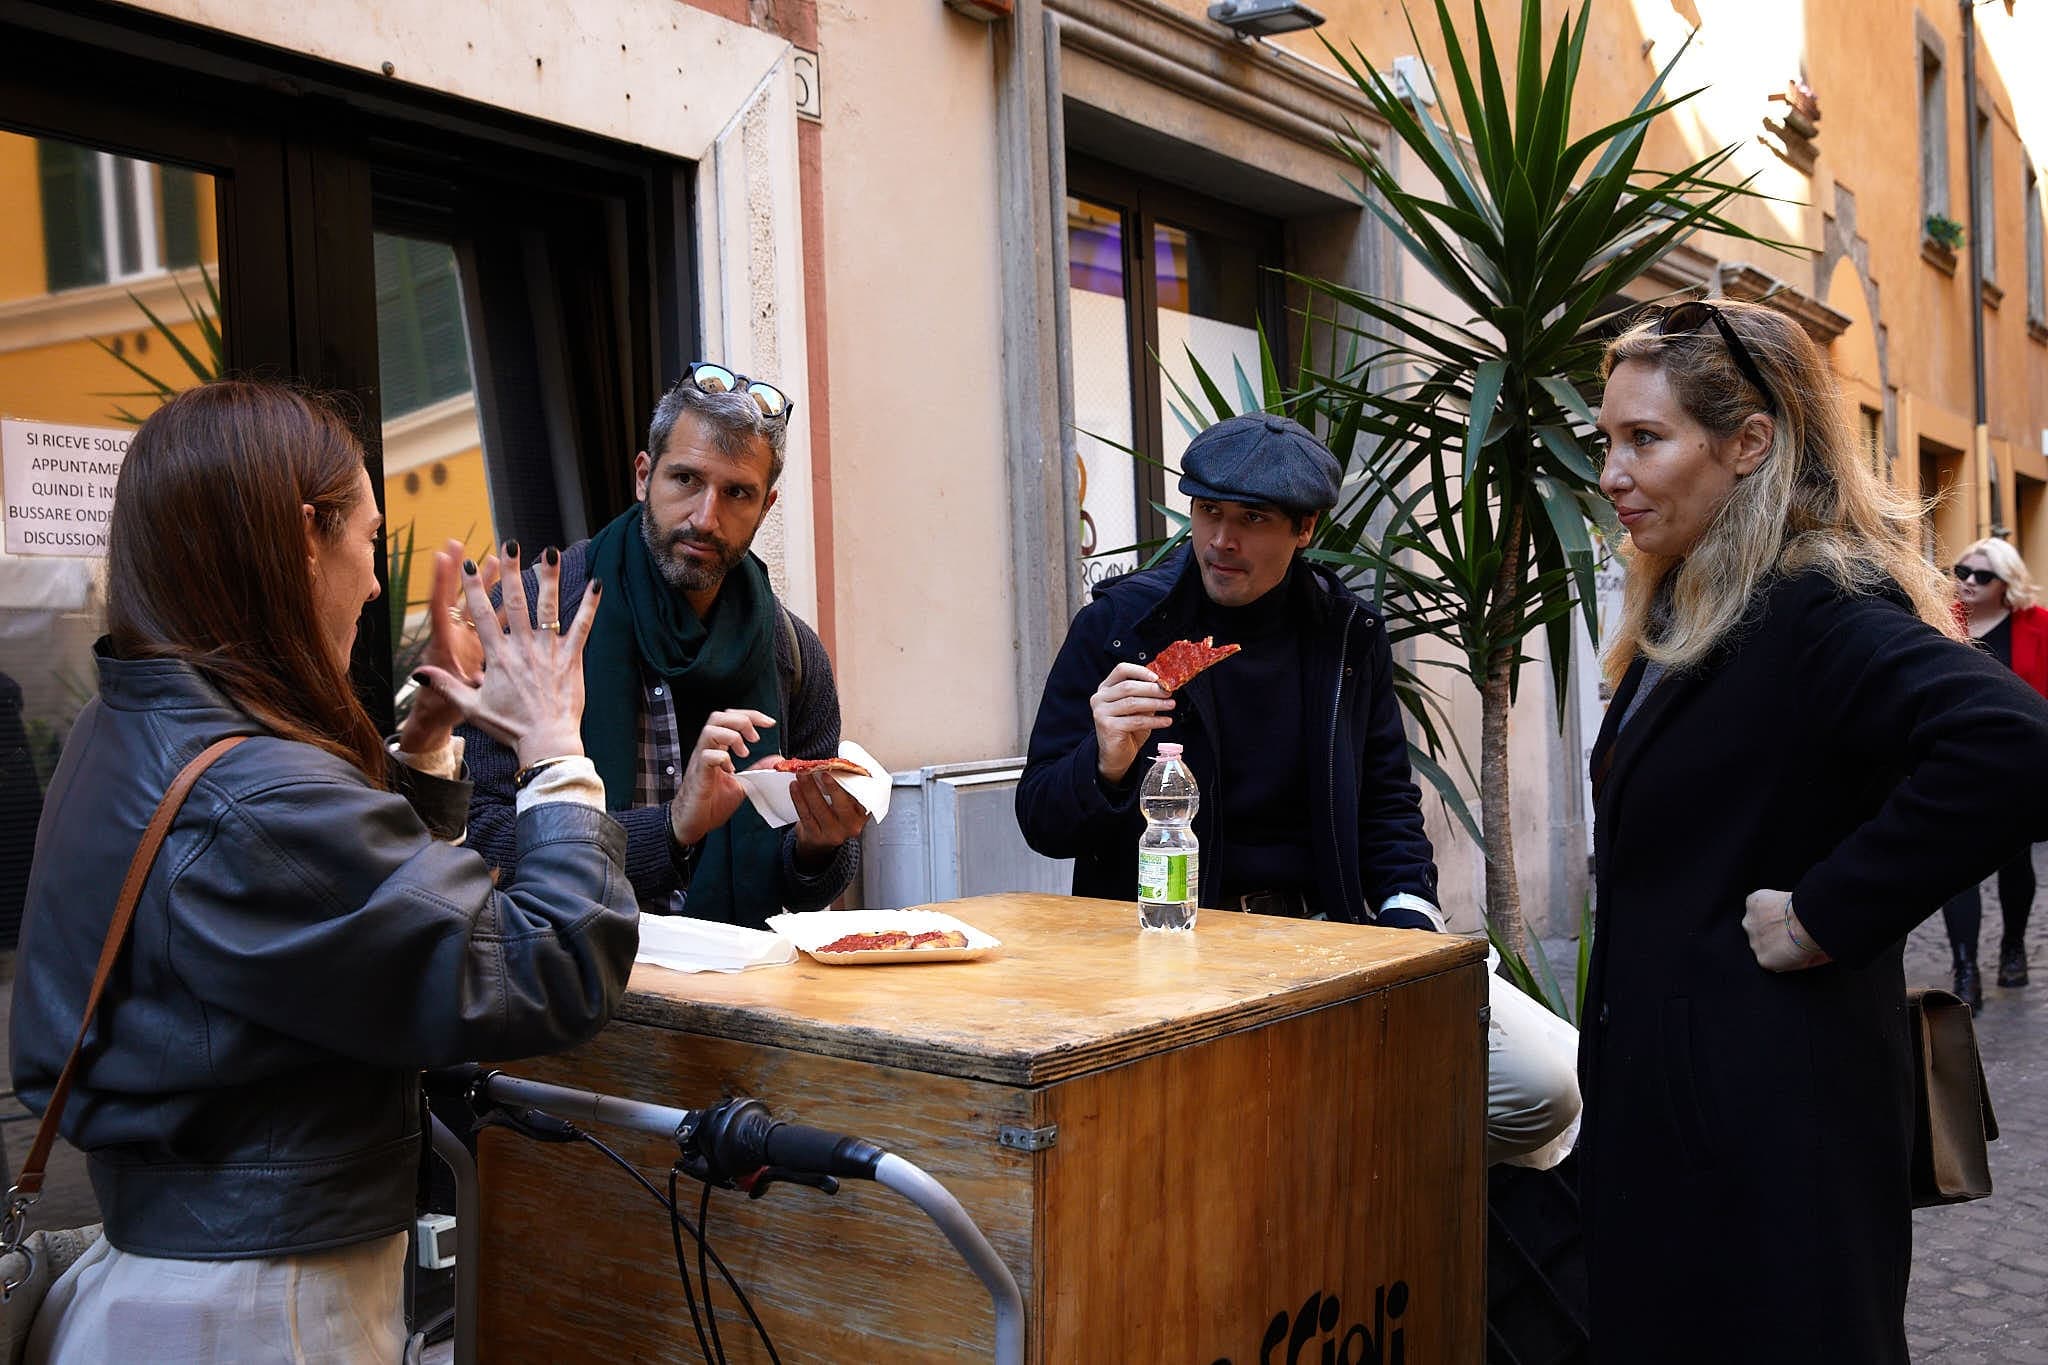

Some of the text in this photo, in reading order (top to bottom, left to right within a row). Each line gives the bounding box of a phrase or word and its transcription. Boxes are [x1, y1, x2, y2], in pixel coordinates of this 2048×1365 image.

[27, 432, 129, 453] SI RICEVE SOLO
[31, 458, 119, 476] APPUNTAME
[32, 482, 83, 497] QUINDI
[99, 486, 117, 499] IN
[9, 505, 72, 520] BUSSARE
